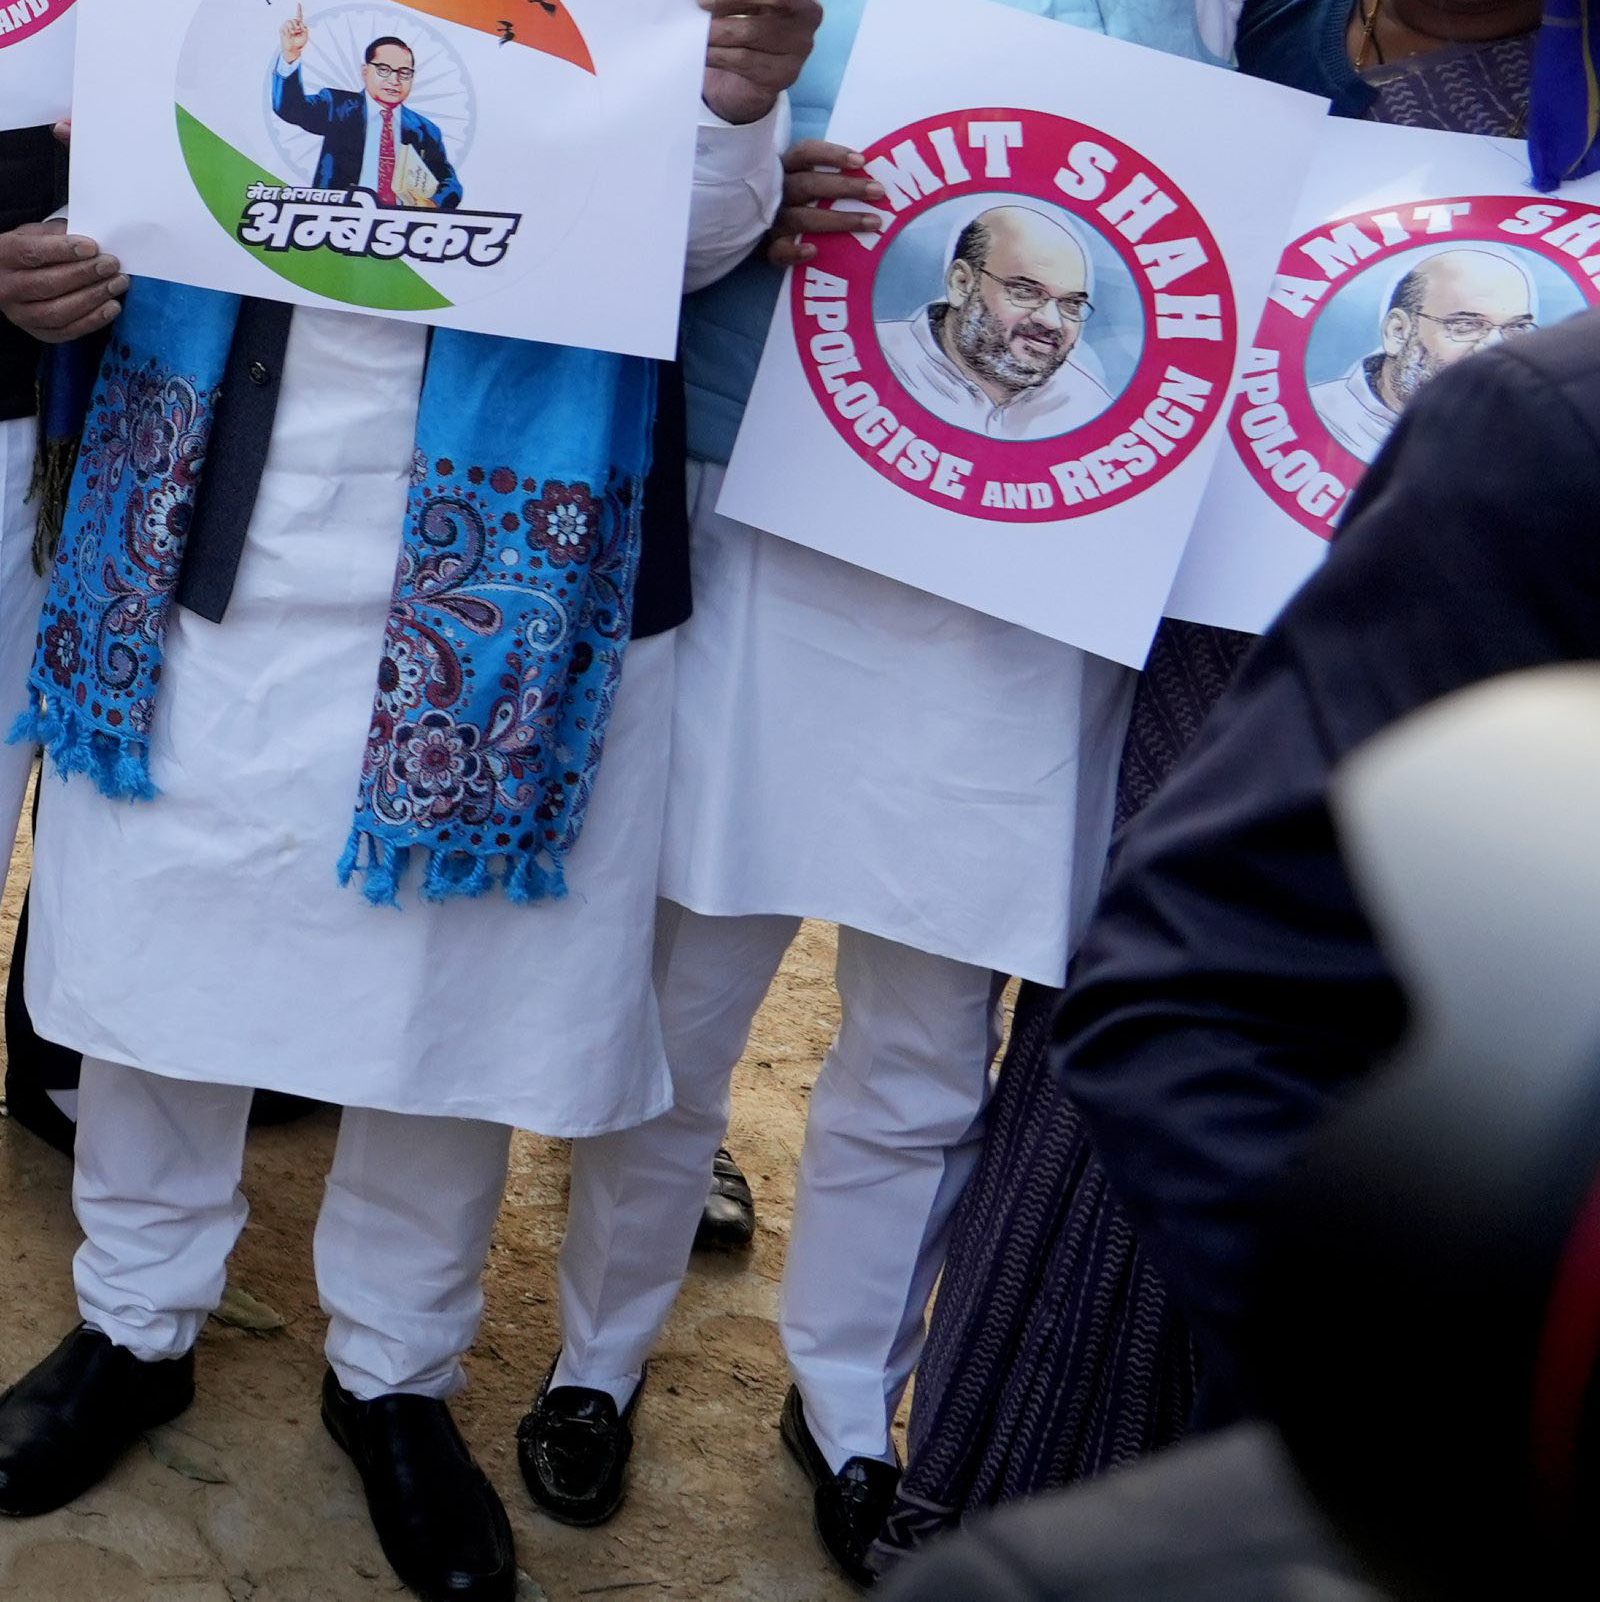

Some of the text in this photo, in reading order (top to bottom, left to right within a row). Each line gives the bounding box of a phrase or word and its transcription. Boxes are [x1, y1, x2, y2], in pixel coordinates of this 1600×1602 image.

[239, 190, 518, 266] अम्बेडकर
[245, 181, 348, 204] मेरा भगवान
[1052, 139, 1225, 342] SHAH
[1267, 202, 1600, 319] AMIT SH
[803, 265, 1214, 510] APOLOGISE AND RESIGN
[1240, 346, 1353, 528] APOLOG
